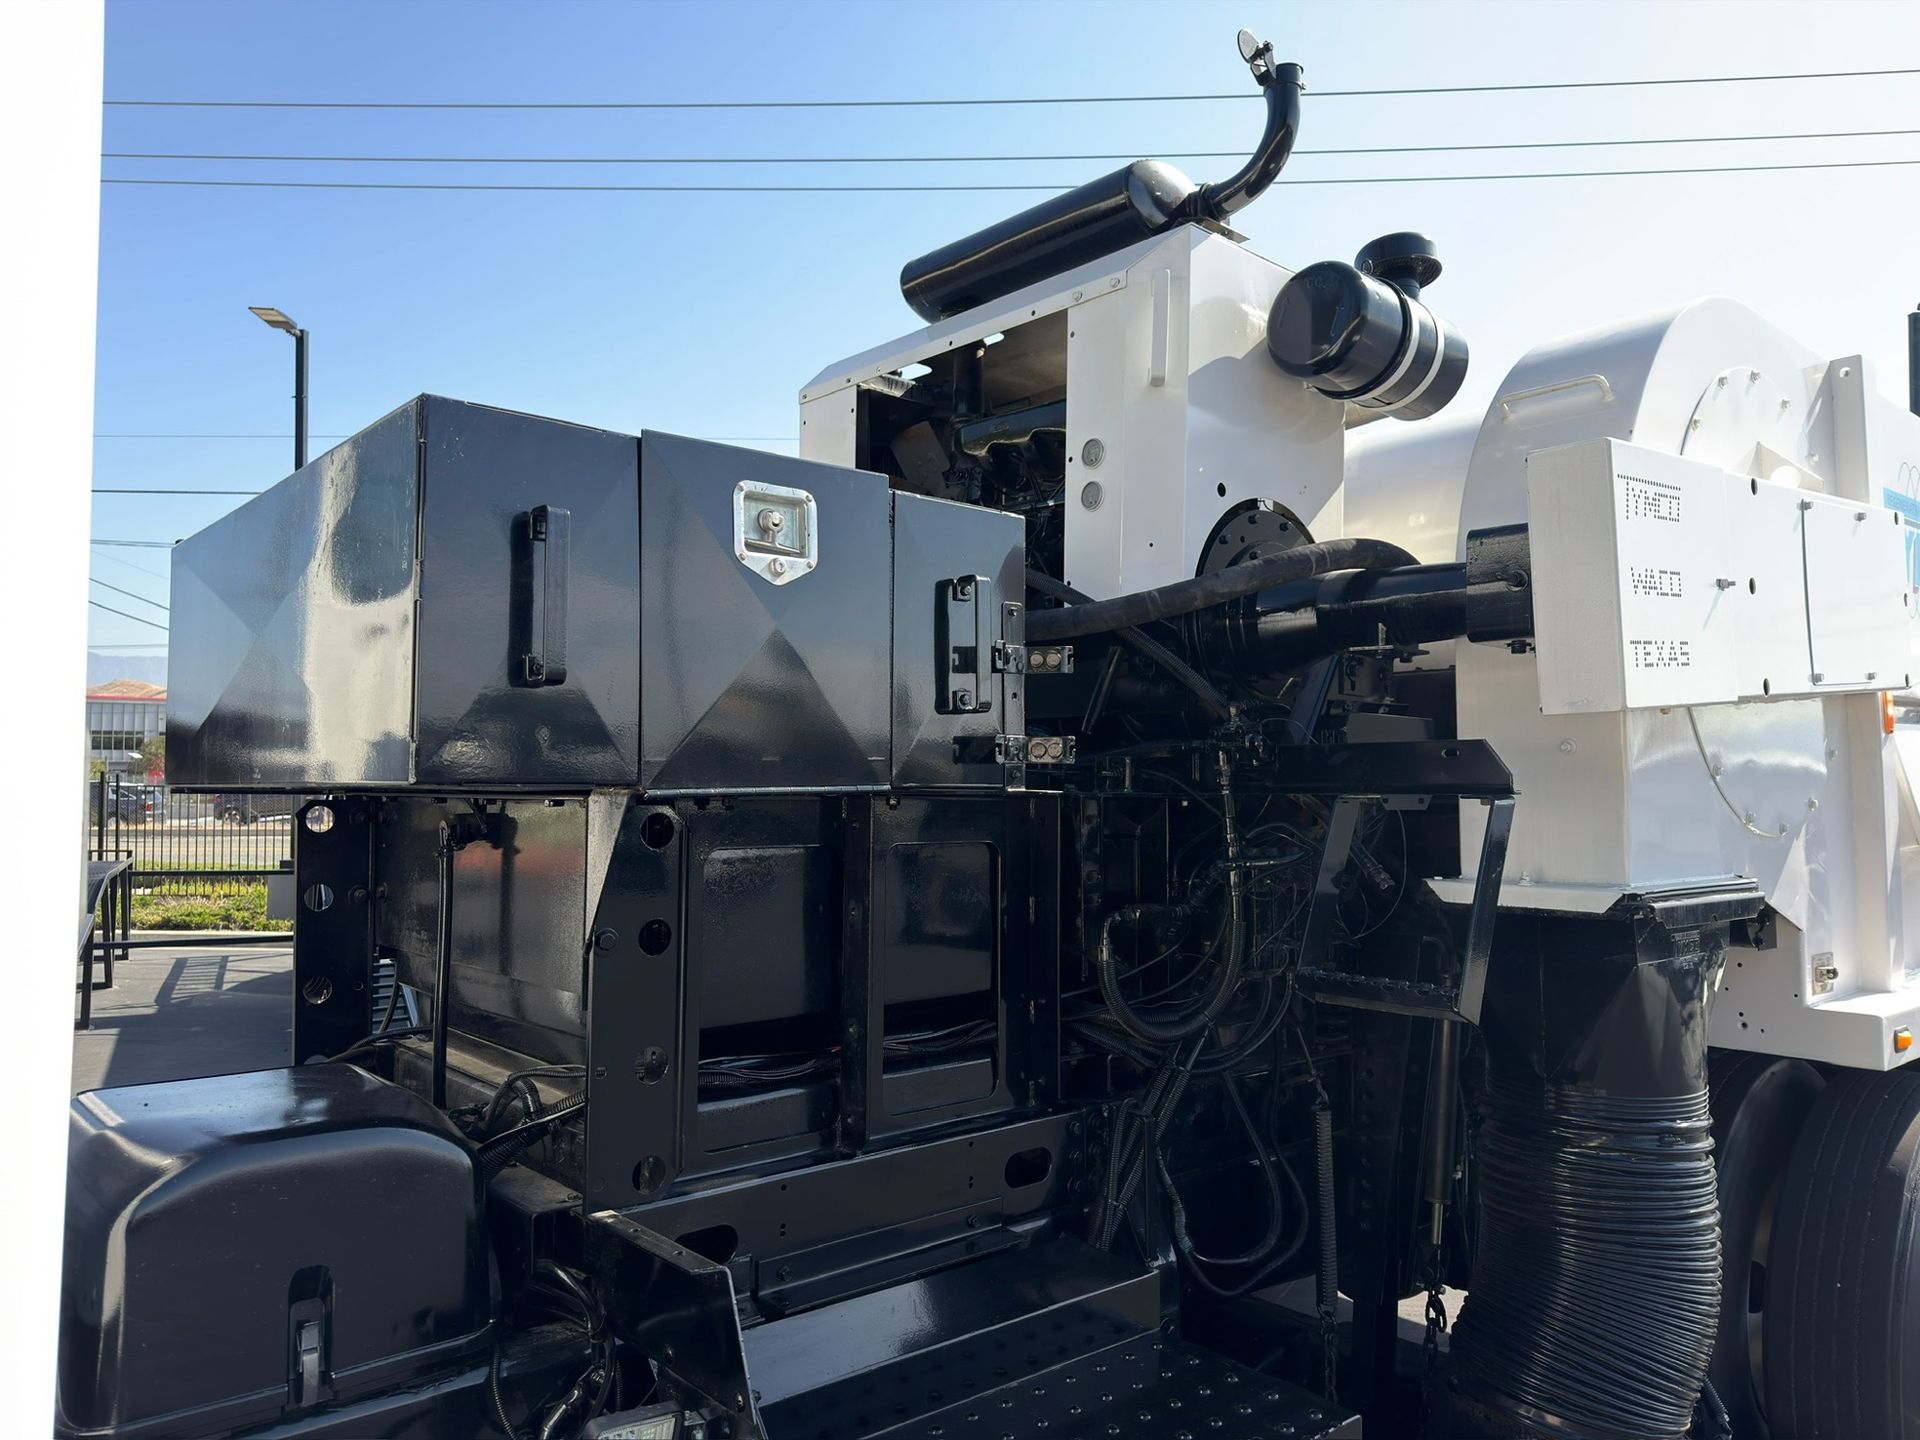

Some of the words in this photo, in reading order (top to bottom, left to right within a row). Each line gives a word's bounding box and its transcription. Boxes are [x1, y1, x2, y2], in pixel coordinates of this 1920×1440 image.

[1617, 473, 1682, 523] TYMCO
[1630, 566, 1682, 598] WACO
[1629, 640, 1691, 669] TEXAS
